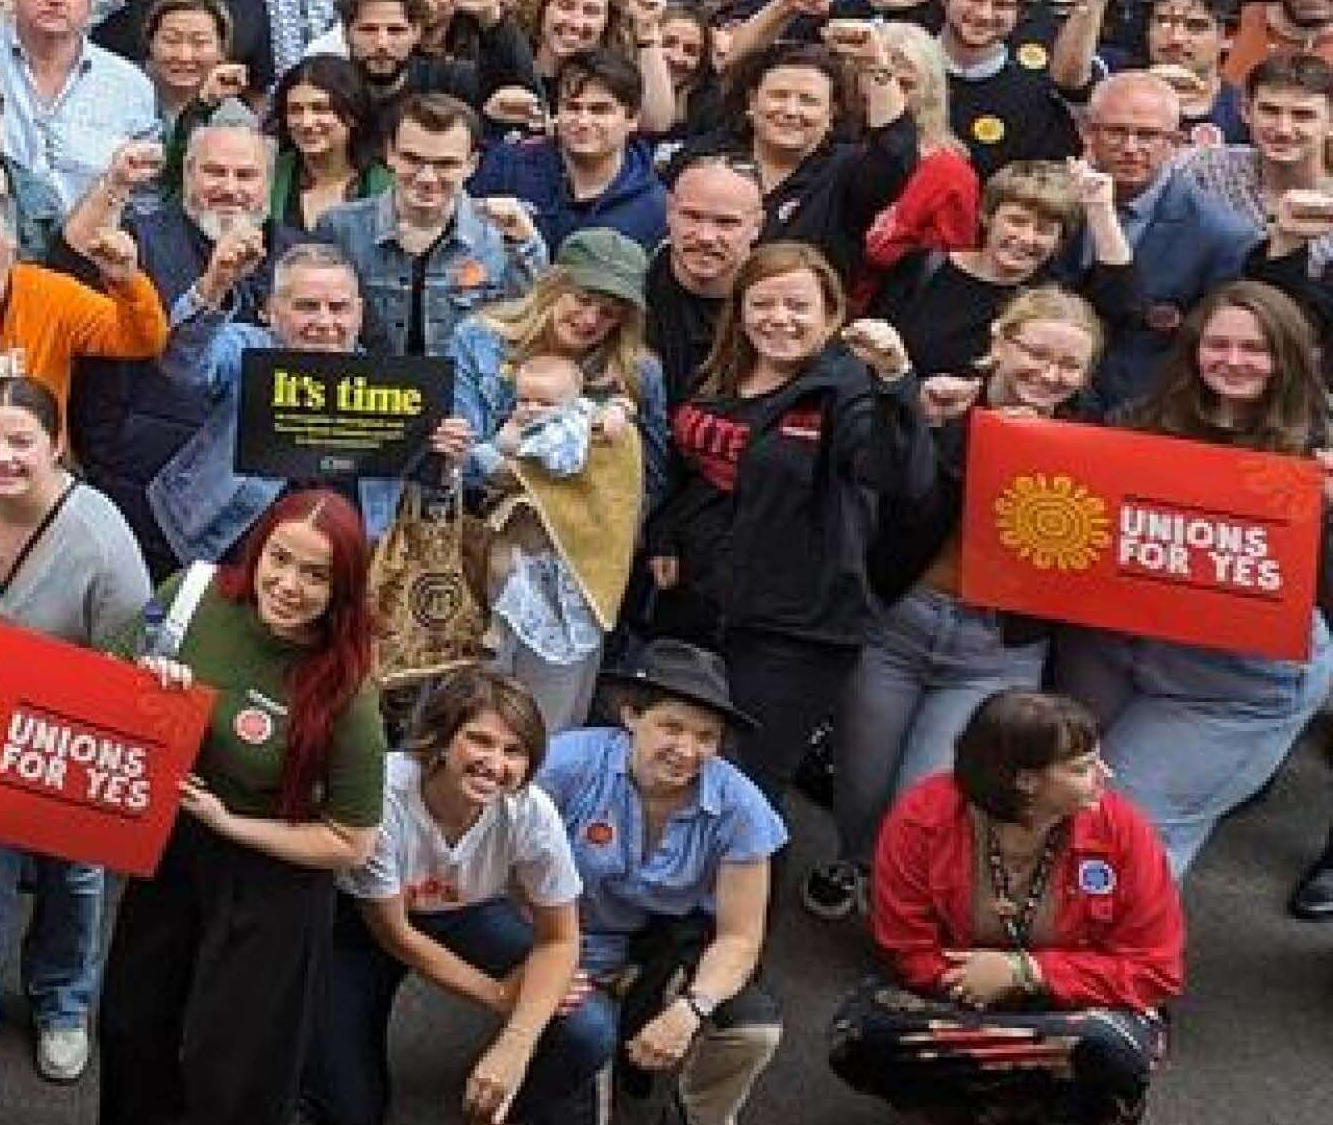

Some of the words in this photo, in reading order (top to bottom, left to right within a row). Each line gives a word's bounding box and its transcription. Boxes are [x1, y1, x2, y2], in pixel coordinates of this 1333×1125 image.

[271, 370, 326, 409] It's
[336, 374, 423, 416] time
[1119, 504, 1269, 557] UNIONS
[1118, 537, 1190, 576] FOR
[1207, 550, 1282, 592] YES
[7, 710, 148, 777] UNIONS
[85, 766, 152, 810] YES
